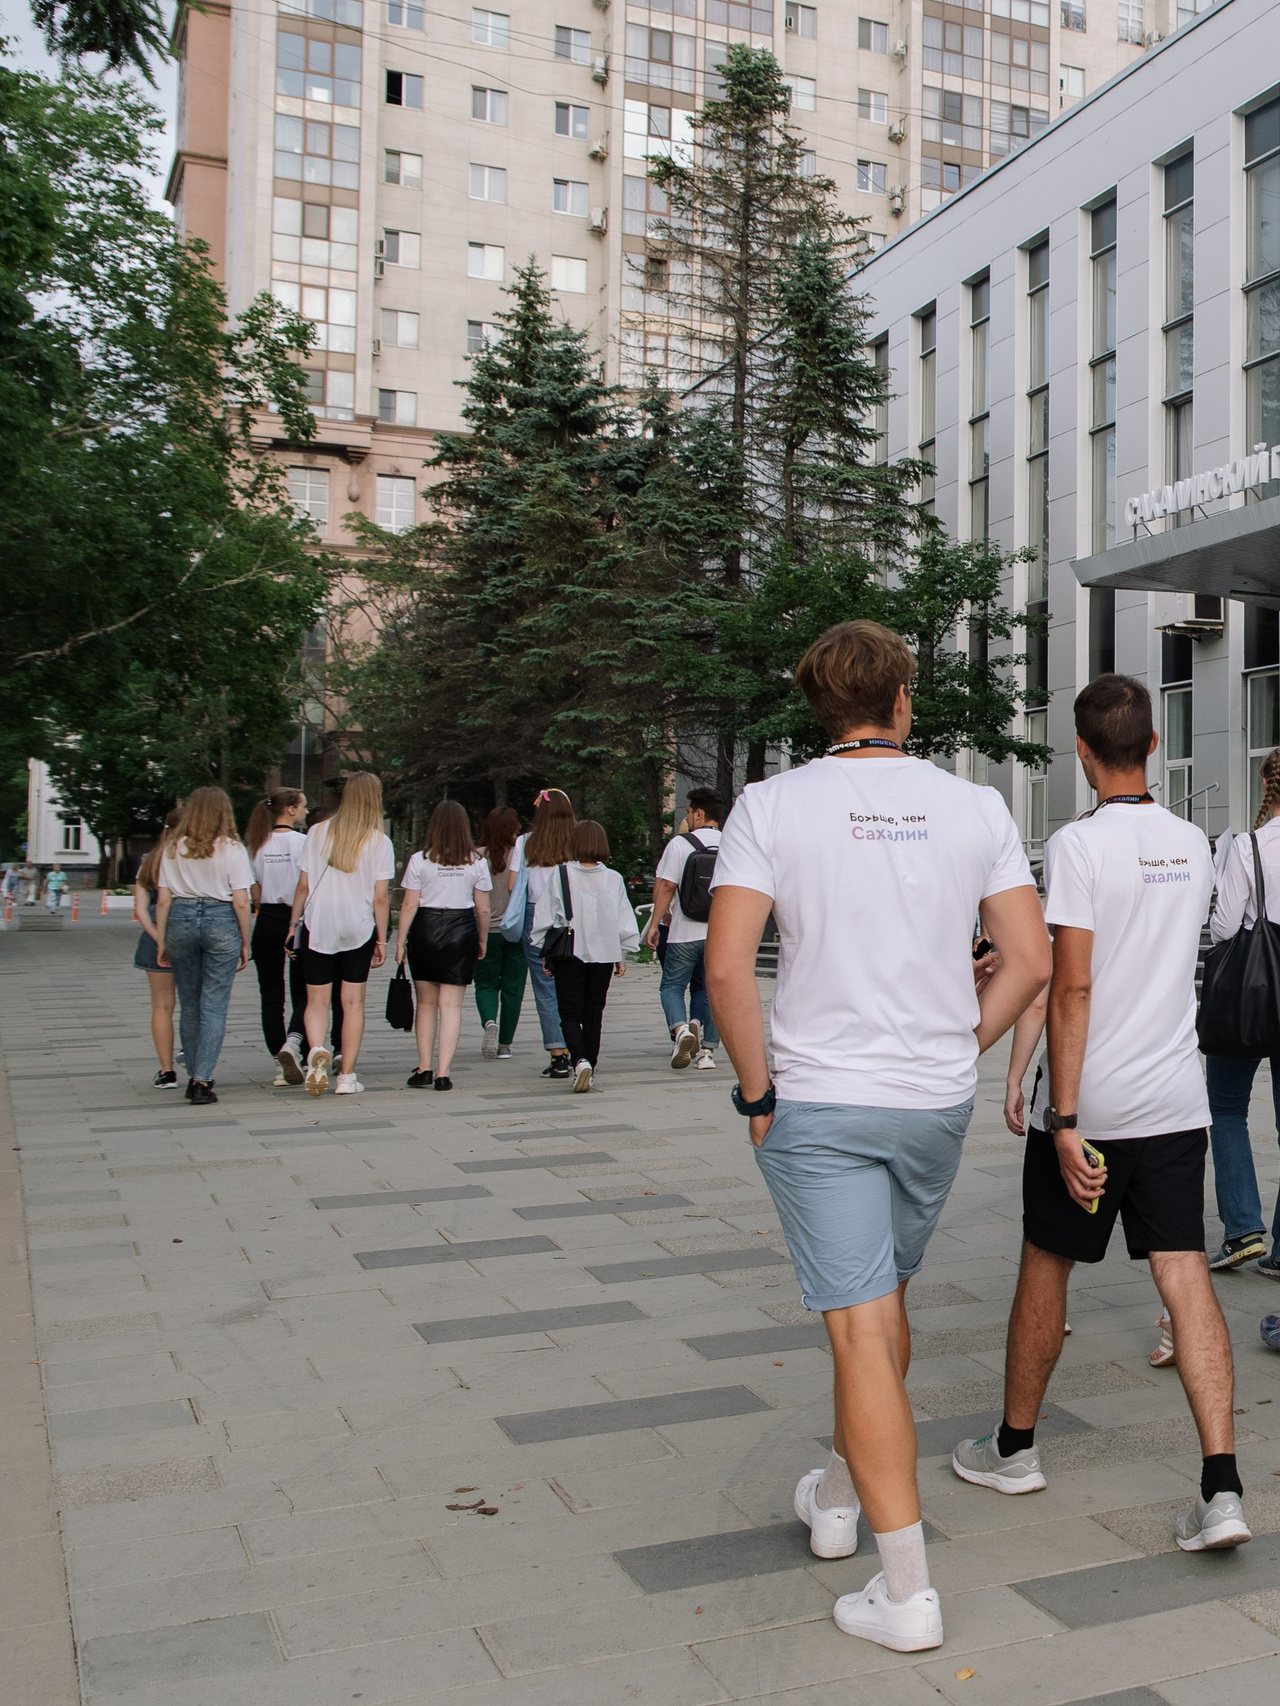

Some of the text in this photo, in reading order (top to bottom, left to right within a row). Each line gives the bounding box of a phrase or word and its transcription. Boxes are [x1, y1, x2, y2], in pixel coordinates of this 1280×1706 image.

[902, 814, 927, 823] чем
[851, 826, 929, 842] Сахалин
[1169, 858, 1188, 866] чем
[1142, 871, 1191, 884] ахалин
